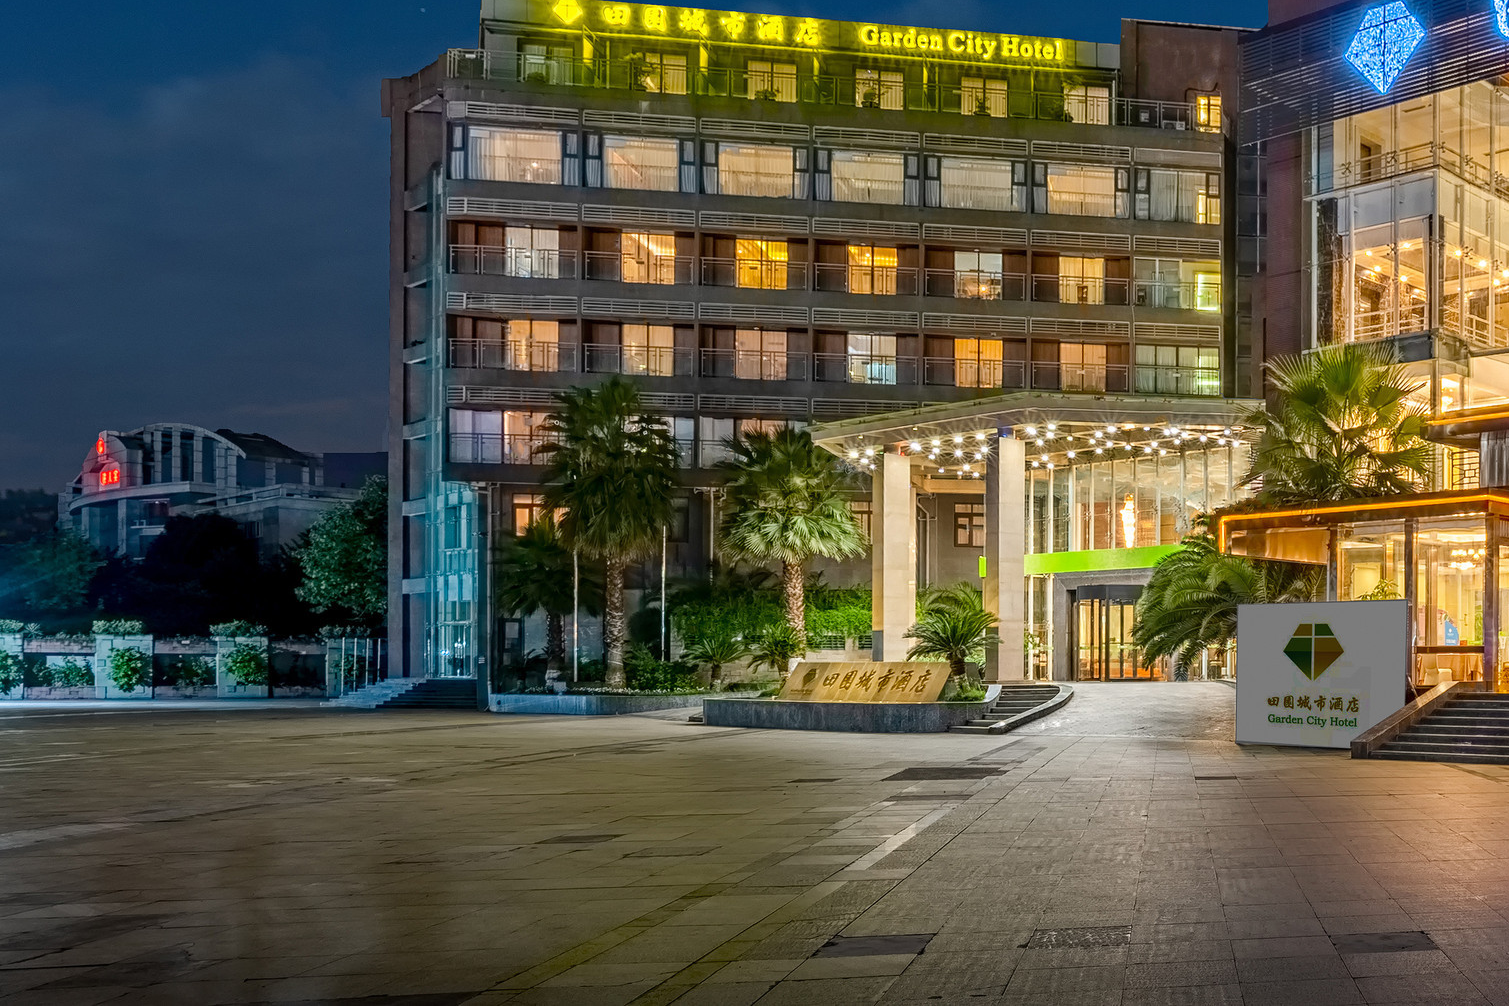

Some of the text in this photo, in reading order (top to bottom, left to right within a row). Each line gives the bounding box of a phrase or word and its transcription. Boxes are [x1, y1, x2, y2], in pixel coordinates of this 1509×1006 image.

[859, 24, 1065, 61] Garden City Hotel
[1267, 714, 1358, 728] Garden City Hotel
